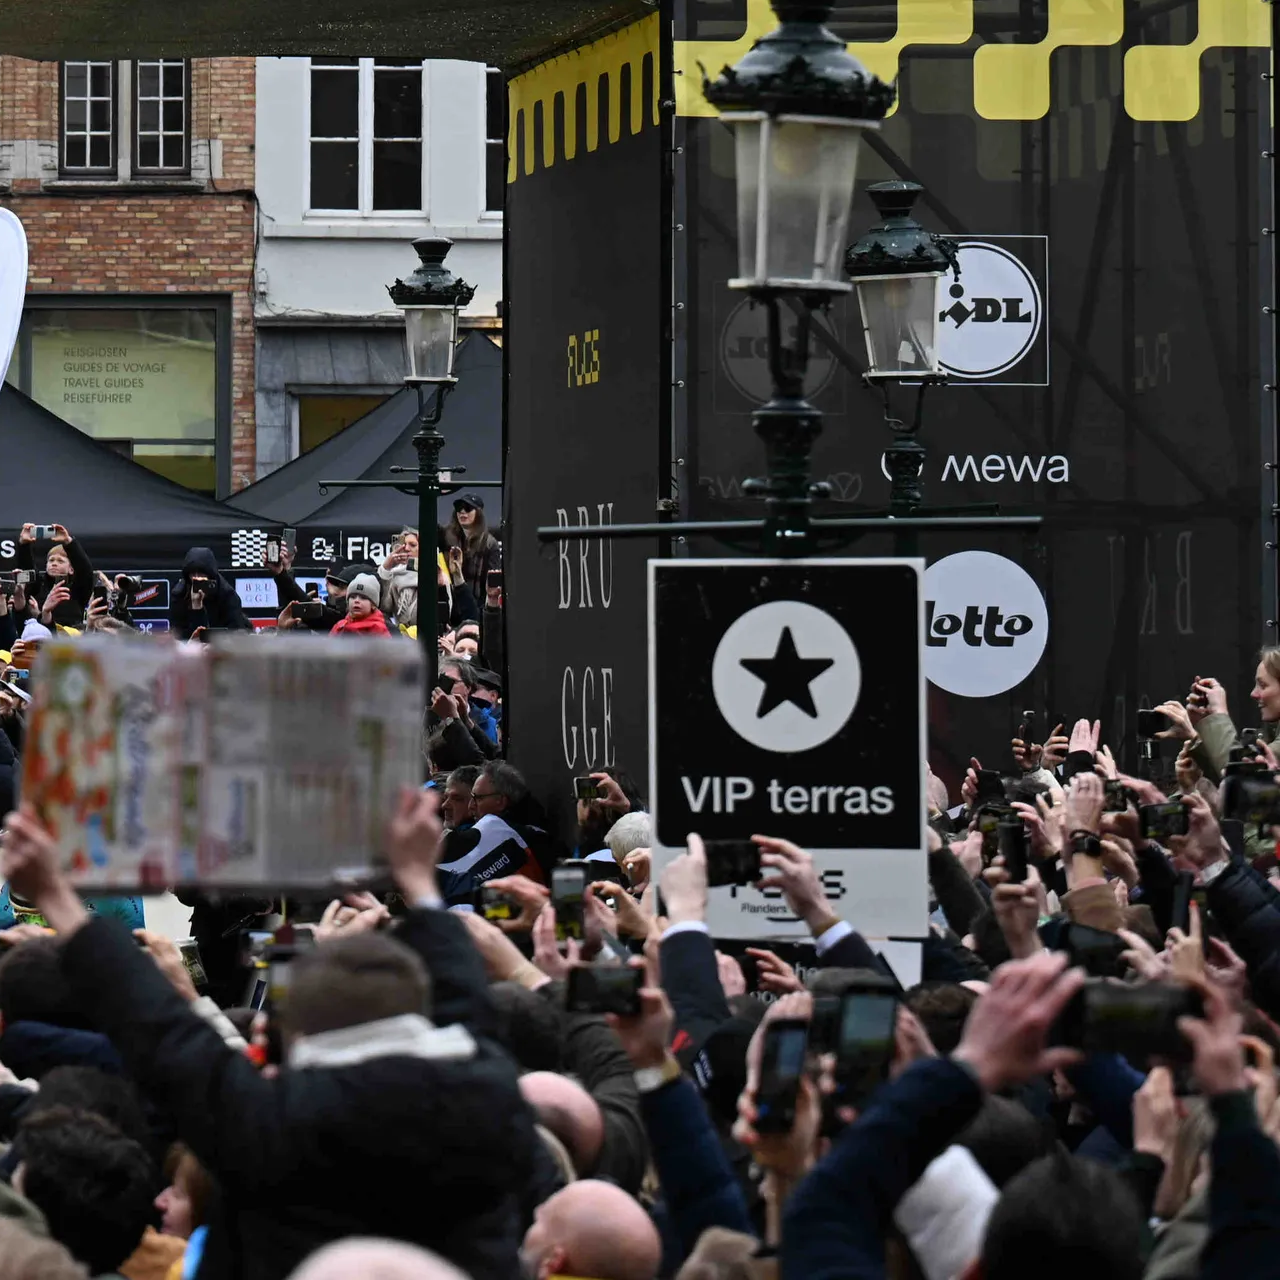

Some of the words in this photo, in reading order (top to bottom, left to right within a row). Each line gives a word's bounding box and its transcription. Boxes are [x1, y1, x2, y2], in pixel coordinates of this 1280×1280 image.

[106, 362, 119, 373] DE
[941, 454, 1070, 483] mewa
[557, 503, 613, 609] BRU
[561, 666, 616, 770] GGE
[680, 776, 754, 813] VIP
[767, 779, 895, 815] terras
[741, 902, 788, 914] Flanders
